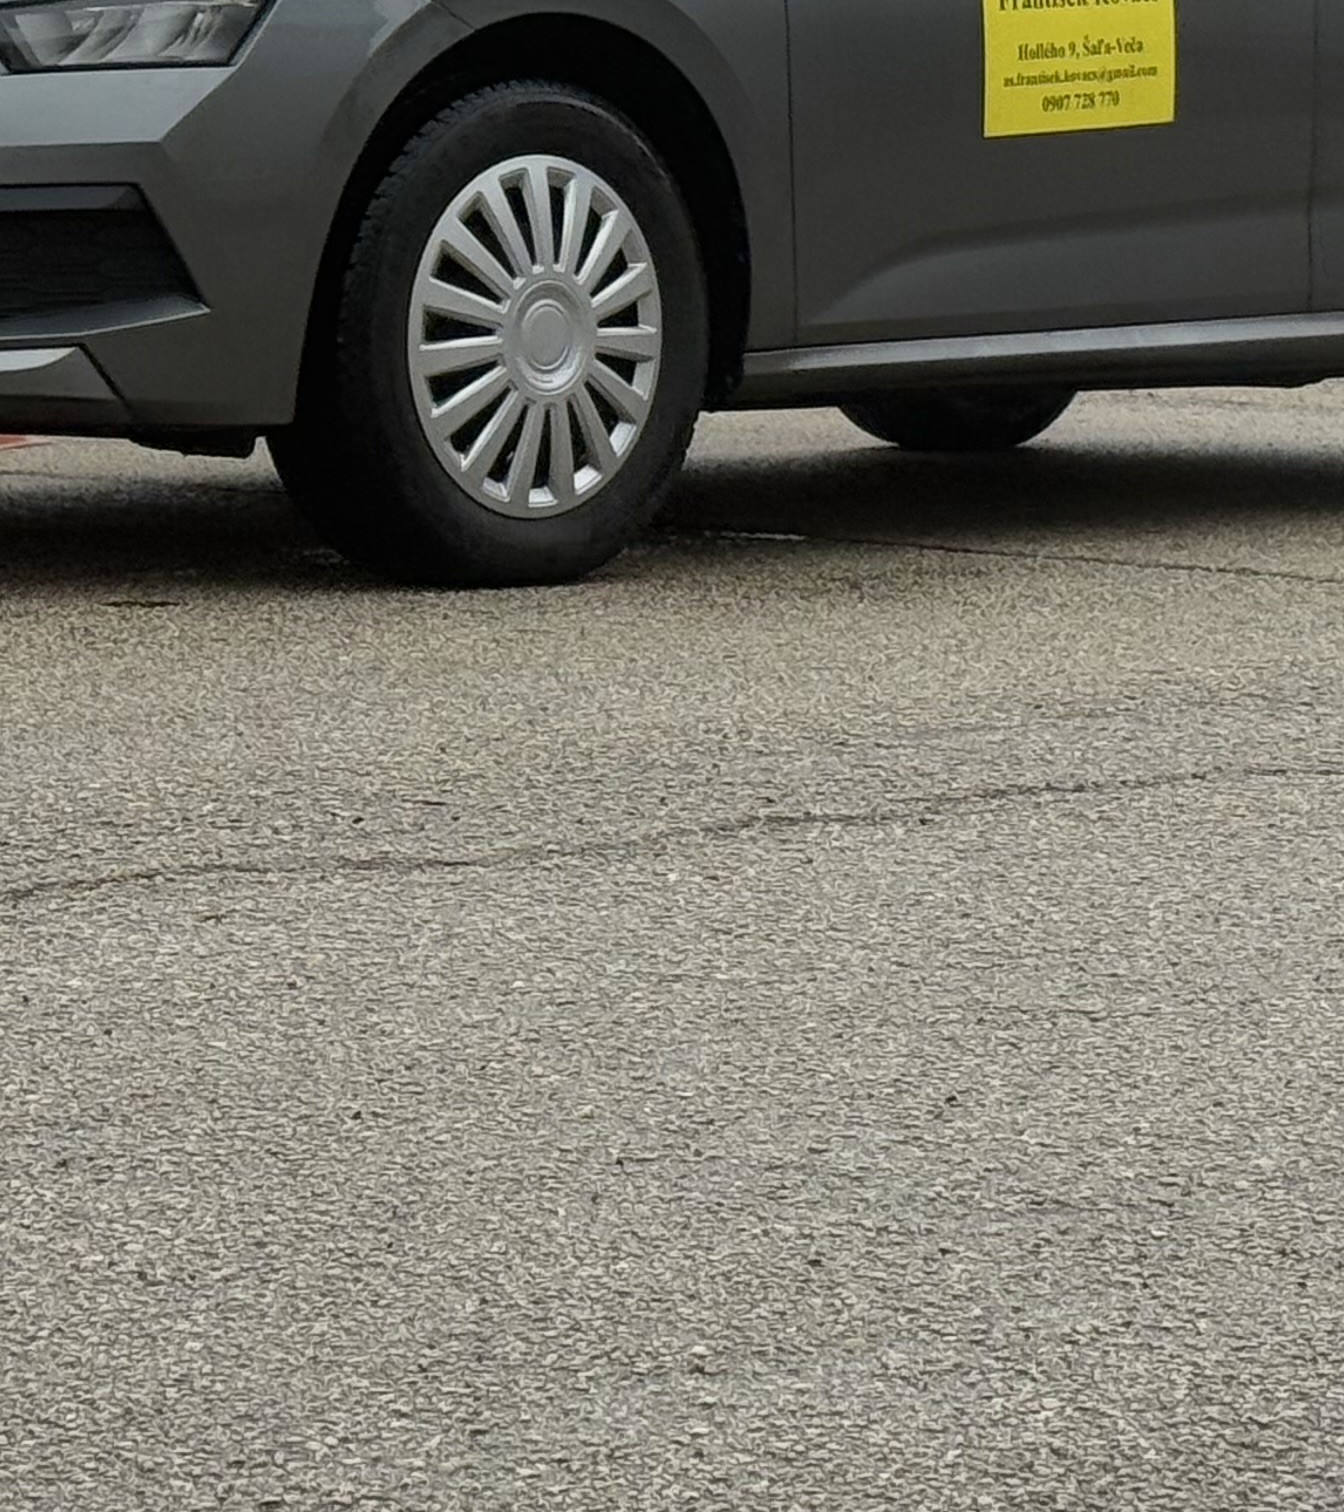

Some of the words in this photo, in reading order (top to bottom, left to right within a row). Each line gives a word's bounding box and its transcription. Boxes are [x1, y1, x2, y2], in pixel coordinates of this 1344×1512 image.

[1017, 42, 1065, 61] Hollého
[1041, 94, 1071, 113] 0907
[1073, 91, 1096, 110] 728
[1098, 90, 1121, 107] 770
